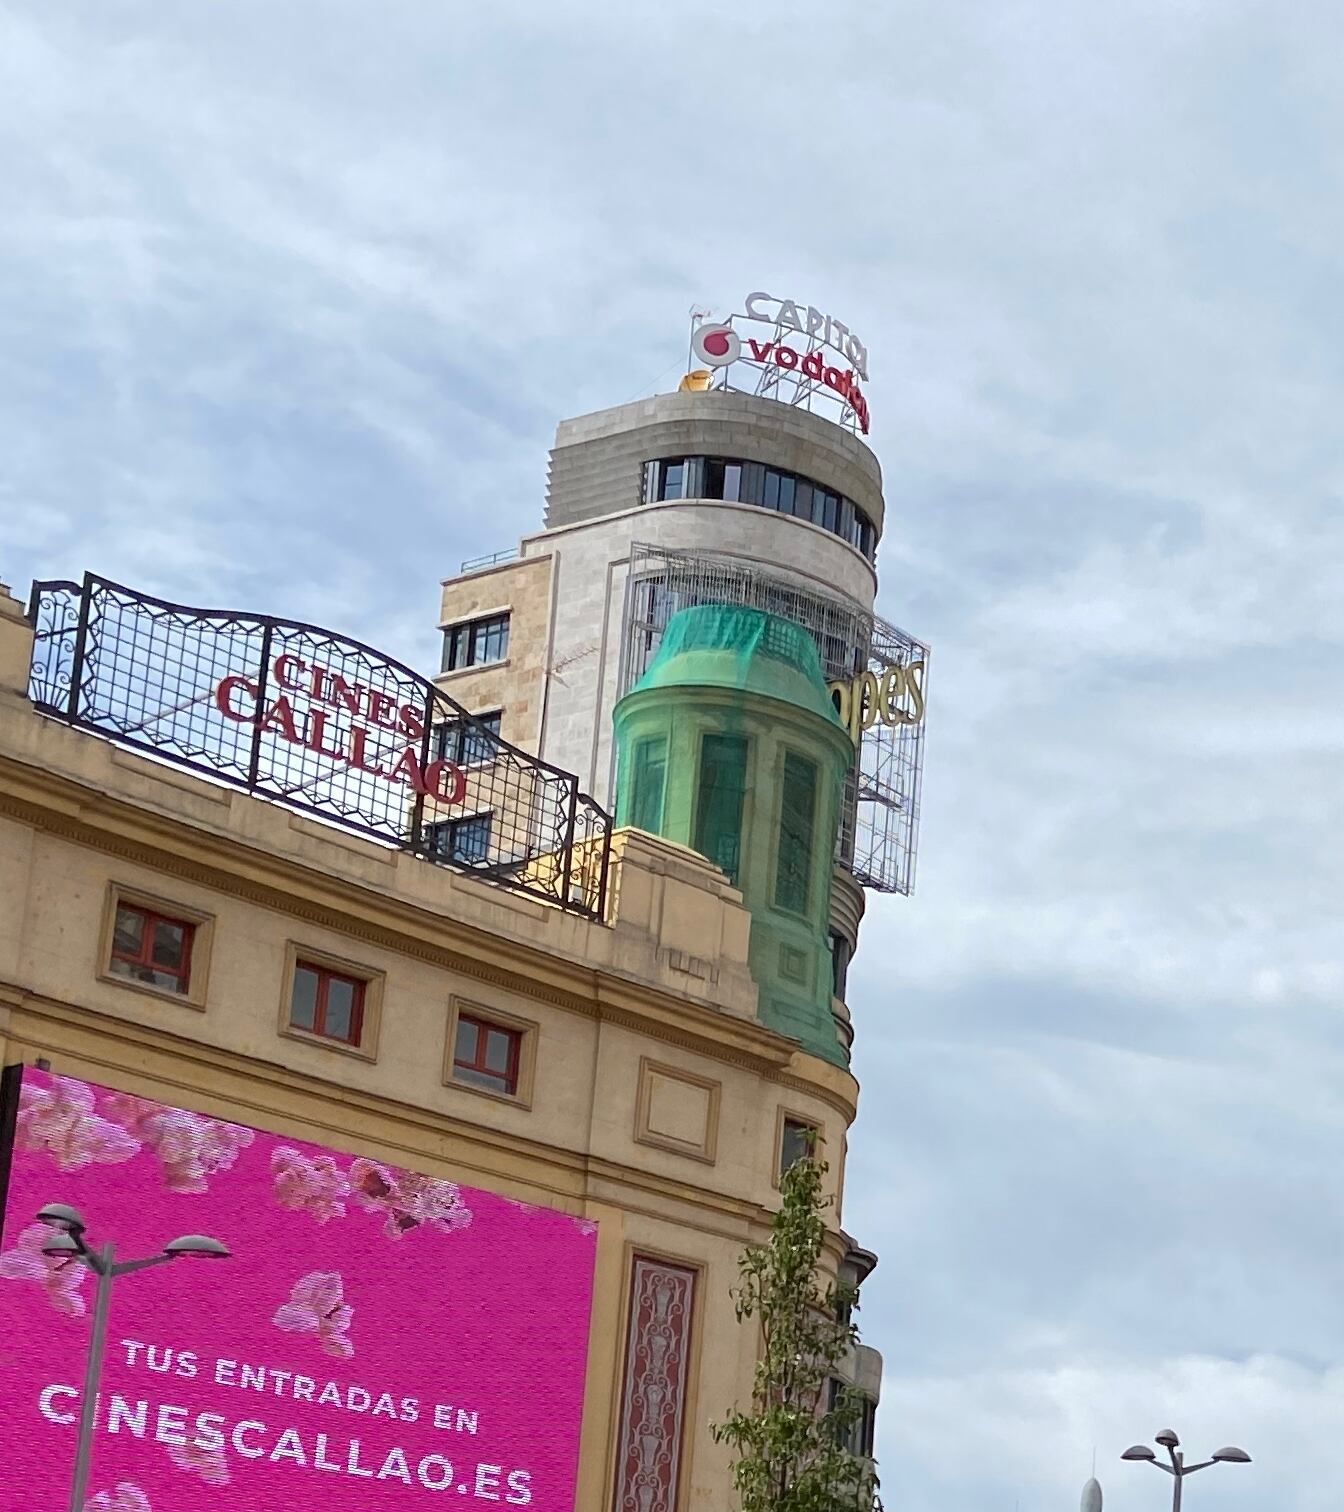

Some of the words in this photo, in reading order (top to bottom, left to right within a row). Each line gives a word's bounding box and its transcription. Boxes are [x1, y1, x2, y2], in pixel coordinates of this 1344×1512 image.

[215, 674, 467, 804] CALLAO
[273, 653, 426, 740] CINES
[121, 1339, 199, 1379] TUS
[215, 1358, 419, 1424] ENTRADAS
[433, 1403, 480, 1435] EN
